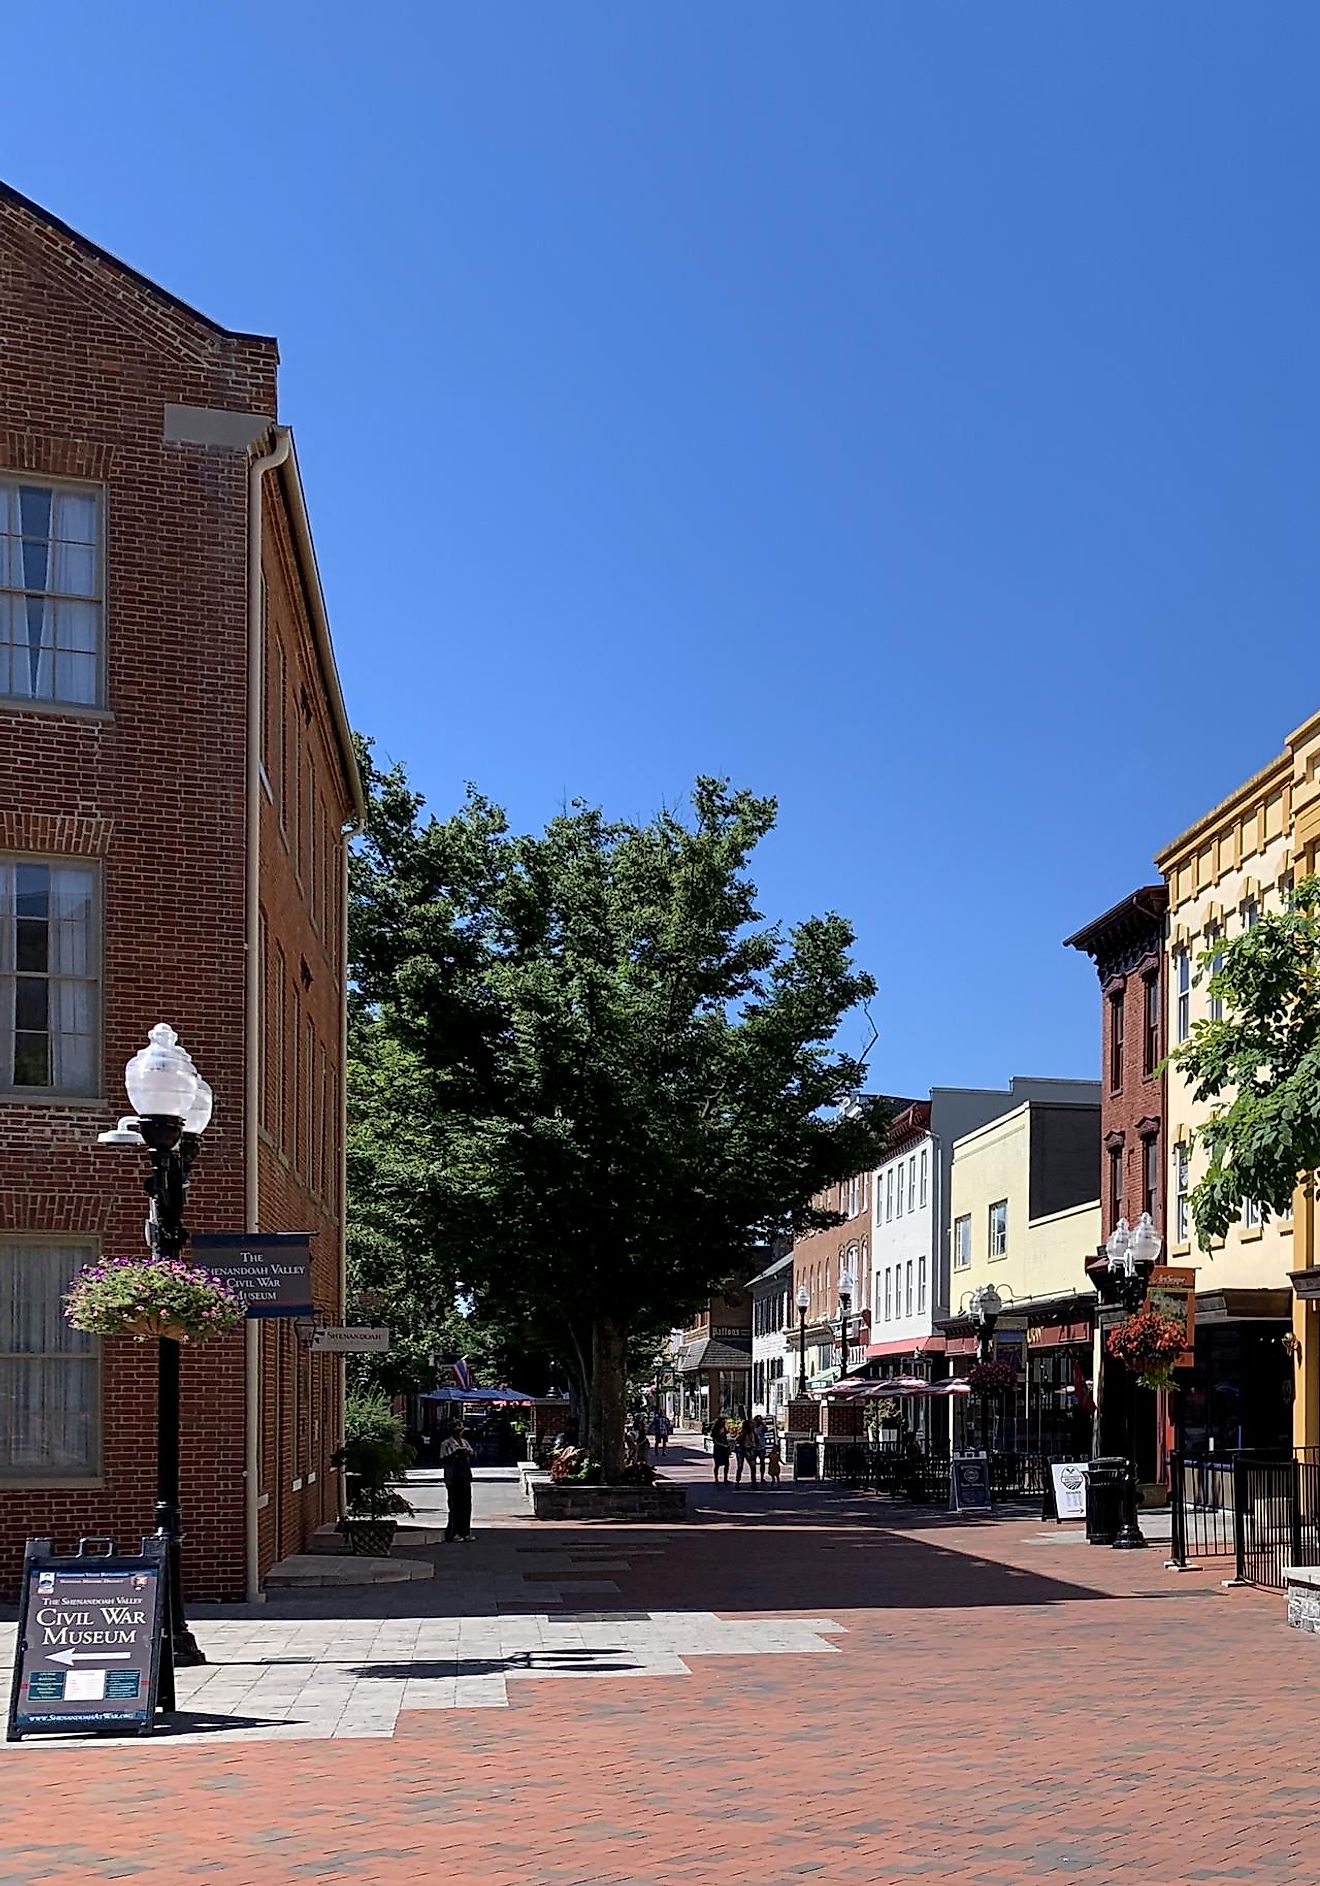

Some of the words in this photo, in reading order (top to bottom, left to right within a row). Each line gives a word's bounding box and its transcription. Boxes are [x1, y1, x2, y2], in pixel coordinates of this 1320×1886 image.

[240, 1252, 264, 1262] THE
[204, 1266, 268, 1276] HENANDOAH
[270, 1264, 306, 1275] VALLEY
[226, 1278, 255, 1288] CIVIL
[255, 1277, 281, 1288] WAR
[327, 1331, 382, 1340] SHENANDOAH
[42, 1598, 60, 1606] THE
[62, 1598, 115, 1606] SHENANDOAH
[116, 1596, 143, 1605] VALLEY
[36, 1608, 94, 1627] CIVIL
[100, 1607, 147, 1625] WAR
[42, 1627, 137, 1645] MUSEUM
